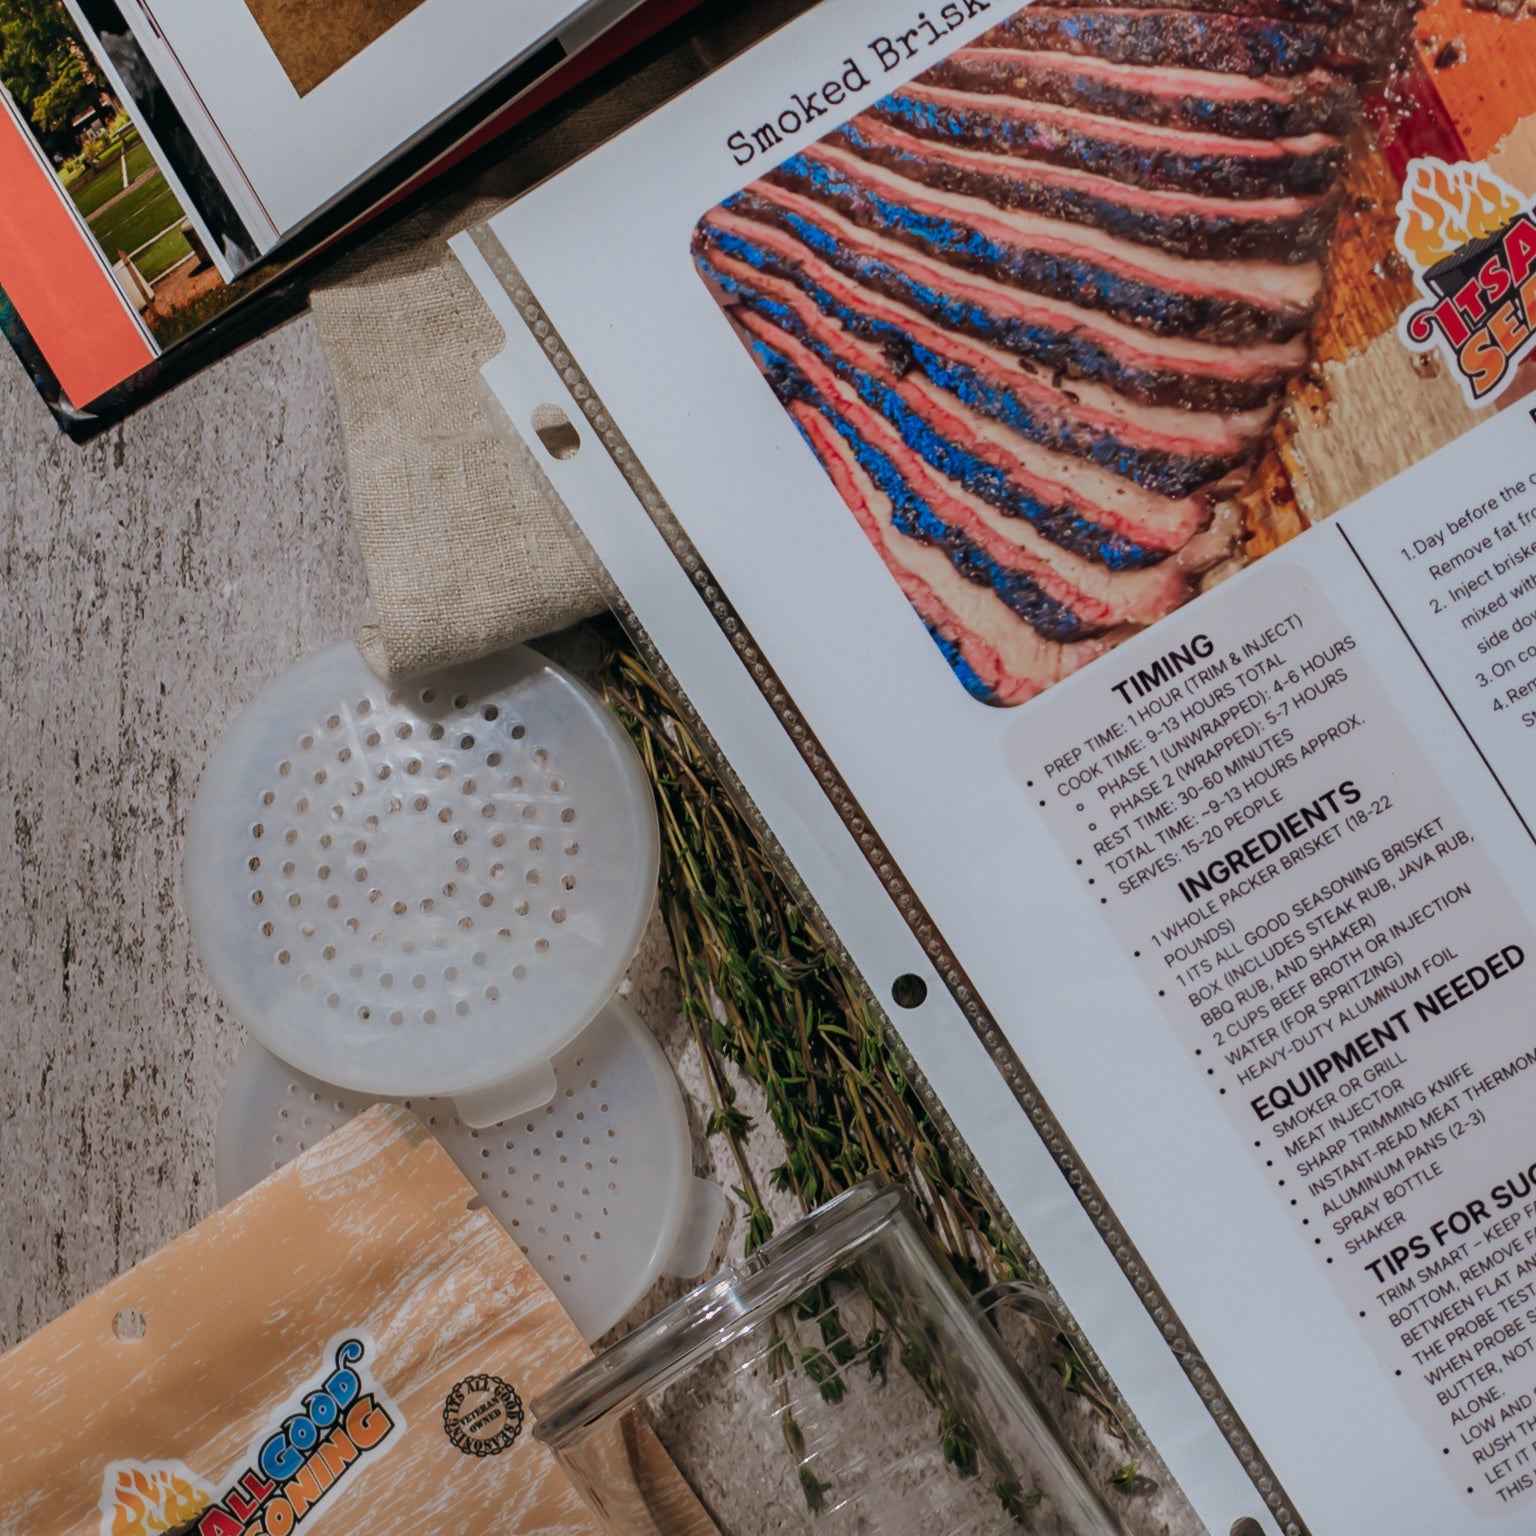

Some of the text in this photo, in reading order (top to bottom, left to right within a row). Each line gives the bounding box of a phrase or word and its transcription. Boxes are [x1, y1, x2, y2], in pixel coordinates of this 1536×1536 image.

[726, 57, 870, 166] Smoked
[1110, 634, 1214, 704] TIMING
[1117, 787, 1283, 894] SERVES: 15-20 PEOPLE
[1177, 780, 1361, 903] INGREDIENTS
[1224, 950, 1403, 1065] WATER (FOR SPRITZING)
[1249, 944, 1524, 1121] EQUIPMENT NEEDED
[1332, 1160, 1443, 1235] SPRAY BOTTLE
[1364, 1234, 1430, 1283] TIPS
[1429, 1199, 1491, 1246] FOR
